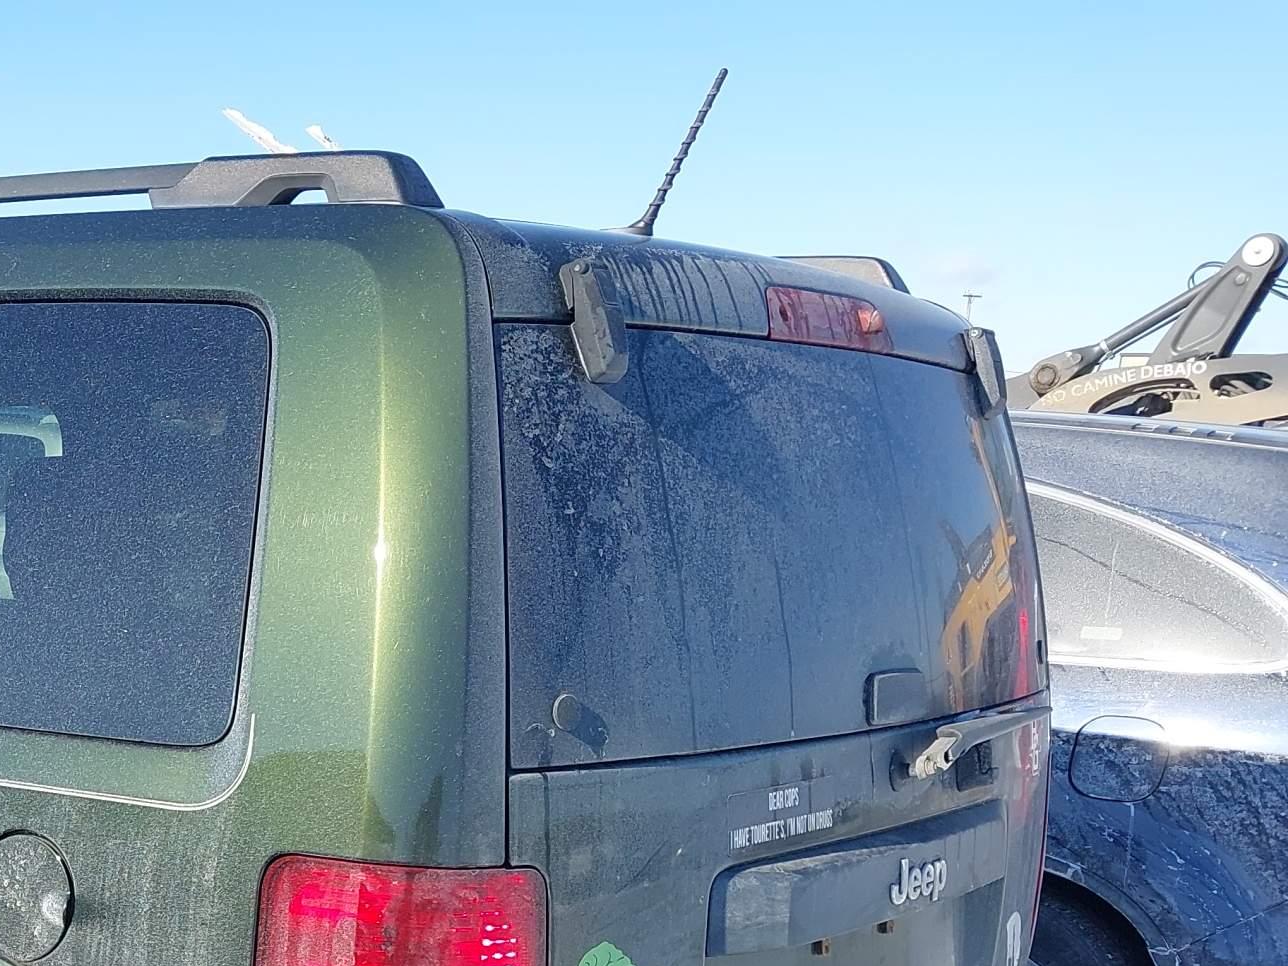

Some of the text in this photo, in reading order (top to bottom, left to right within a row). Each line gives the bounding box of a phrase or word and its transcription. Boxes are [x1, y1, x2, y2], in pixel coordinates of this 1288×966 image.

[1071, 368, 1137, 397] CAMINE
[1141, 357, 1208, 379] DEBAJO
[768, 787, 800, 811] DEAR COPS
[733, 827, 750, 849] HAVE
[796, 814, 807, 835] NOT
[807, 812, 816, 833] ON
[816, 808, 833, 830] DRUGS
[890, 858, 947, 906] Jeep
